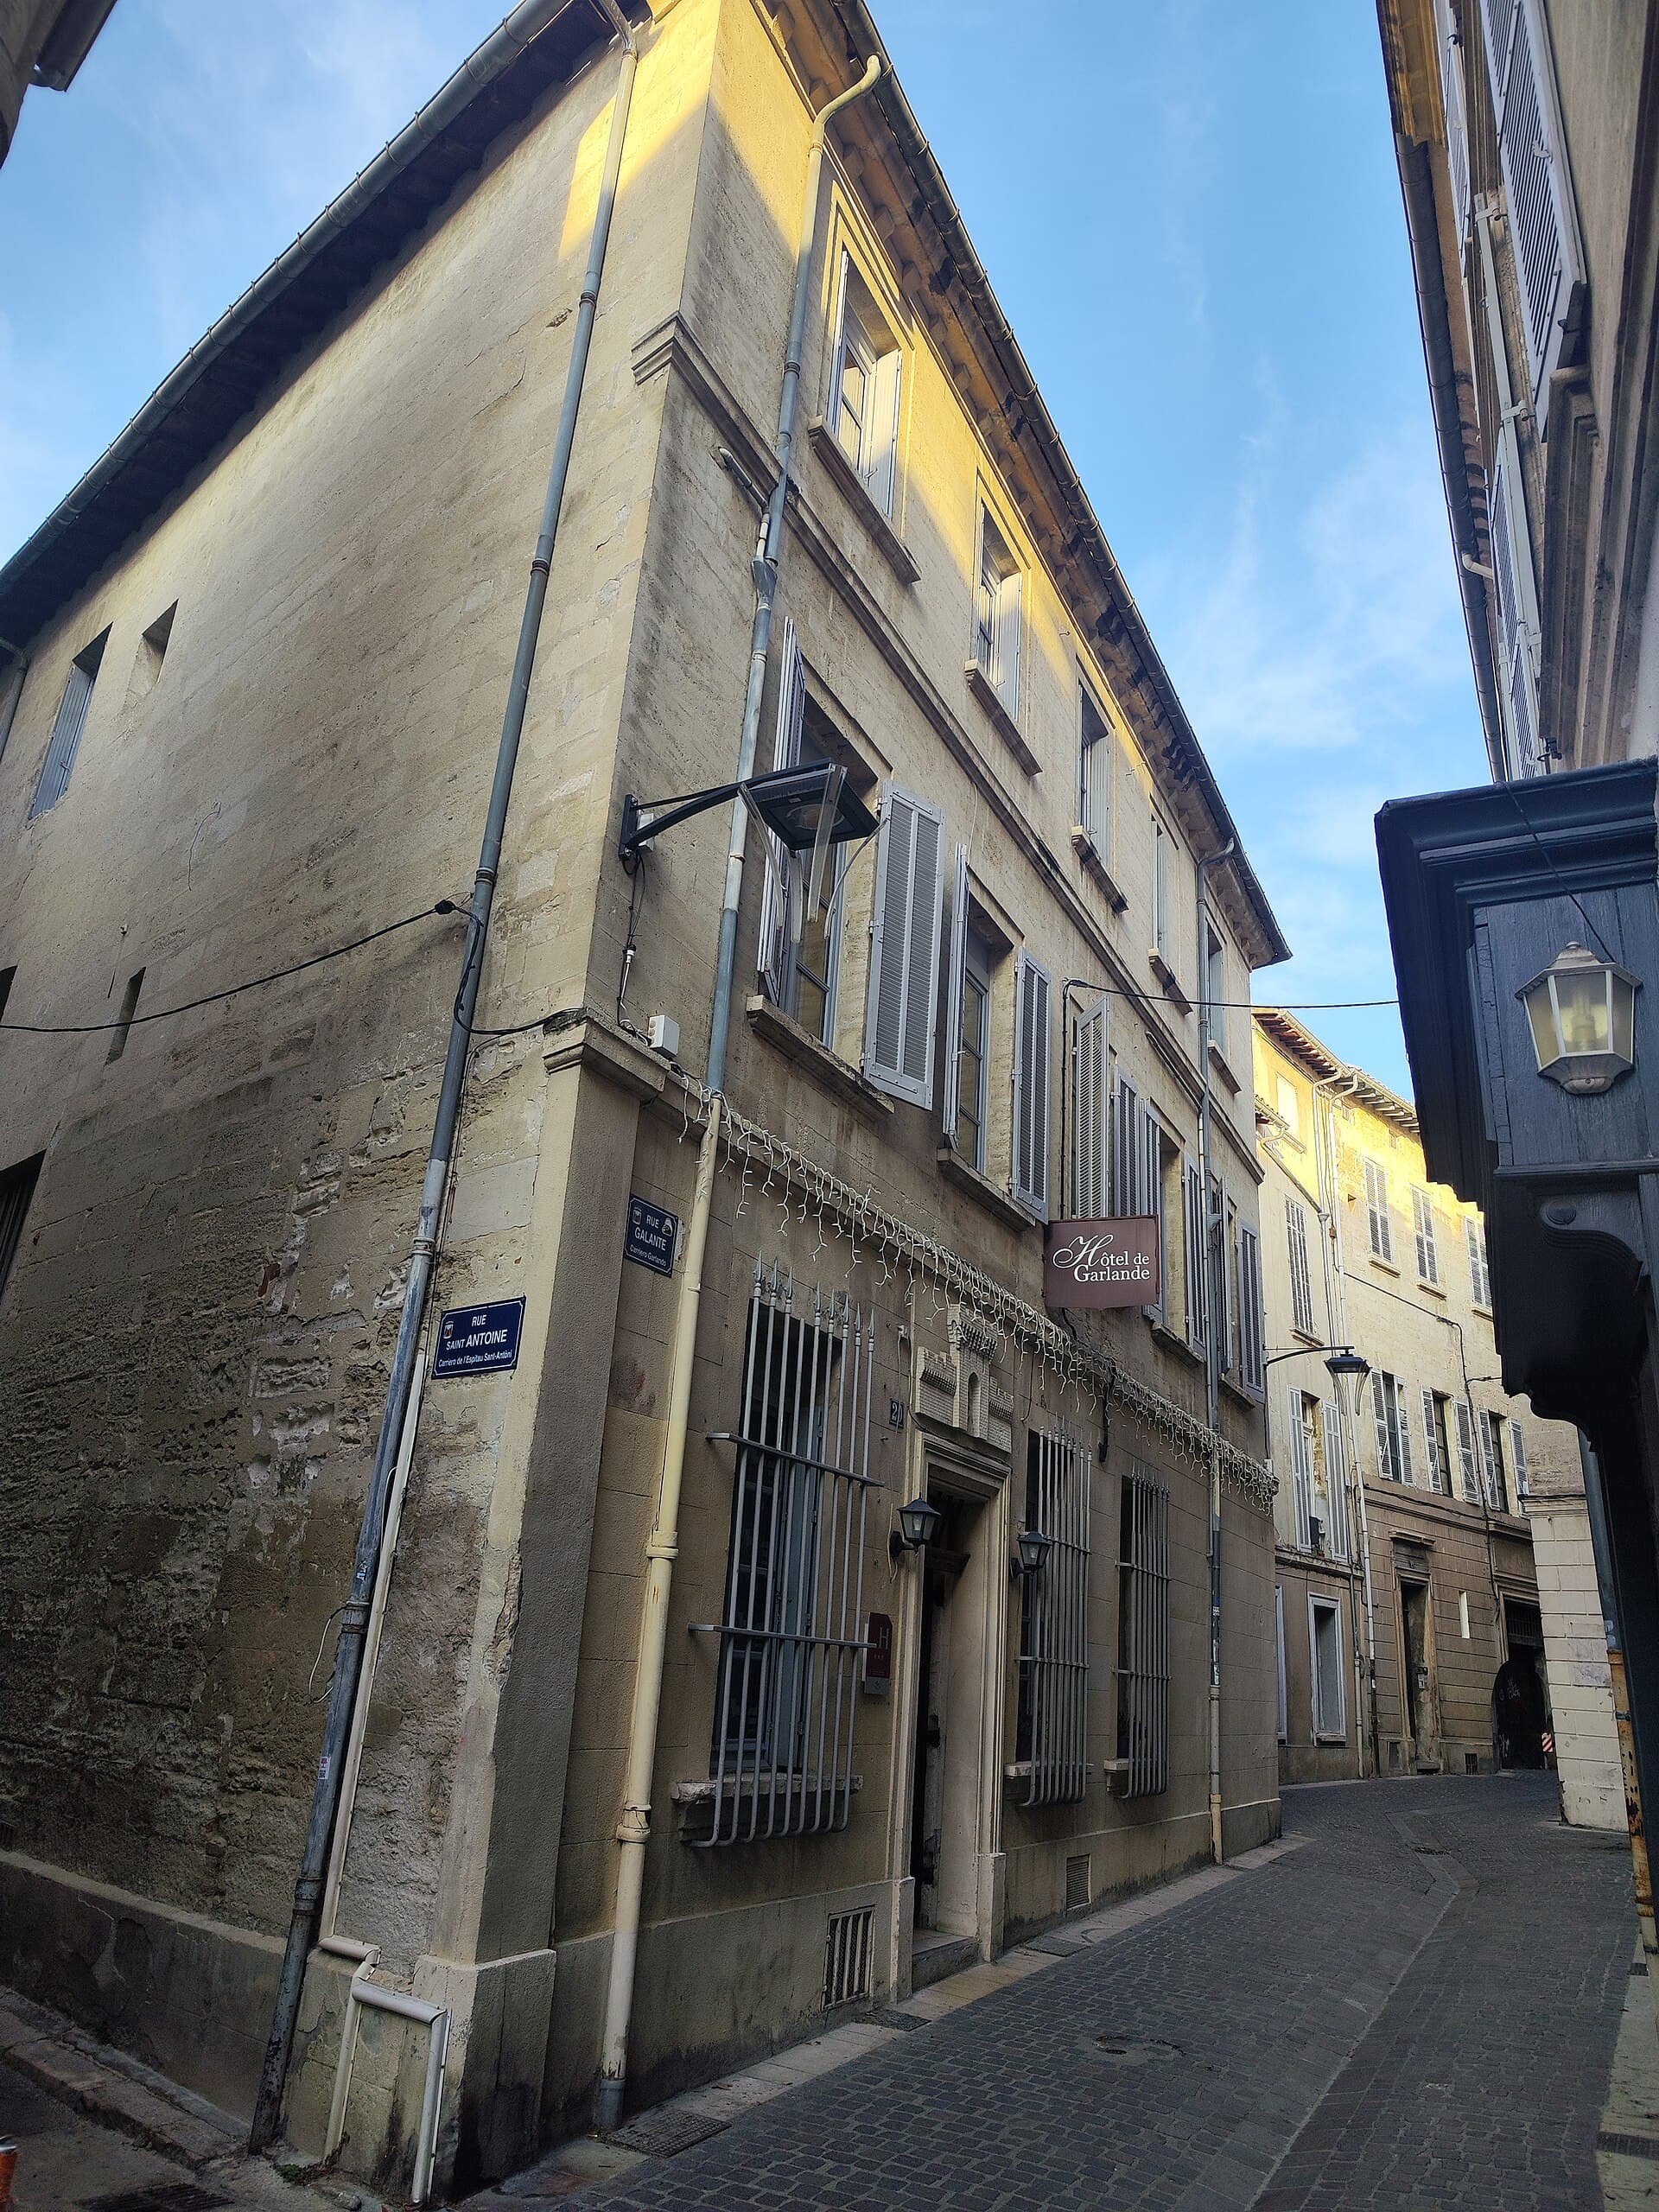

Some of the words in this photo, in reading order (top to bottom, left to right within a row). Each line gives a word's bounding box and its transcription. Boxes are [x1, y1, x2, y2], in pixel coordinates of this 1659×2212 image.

[646, 1215, 659, 1229] RUE
[634, 1227, 667, 1251] GALANTE
[647, 1252, 667, 1267] Garlando
[1052, 1234, 1128, 1268] Hôtel
[1133, 1252, 1150, 1265] de
[1073, 1264, 1150, 1282] Garlande
[472, 1314, 486, 1326] RUE
[446, 1338, 465, 1351] SAINT
[466, 1329, 507, 1348] ANTOINE
[878, 1626, 889, 1650] H
